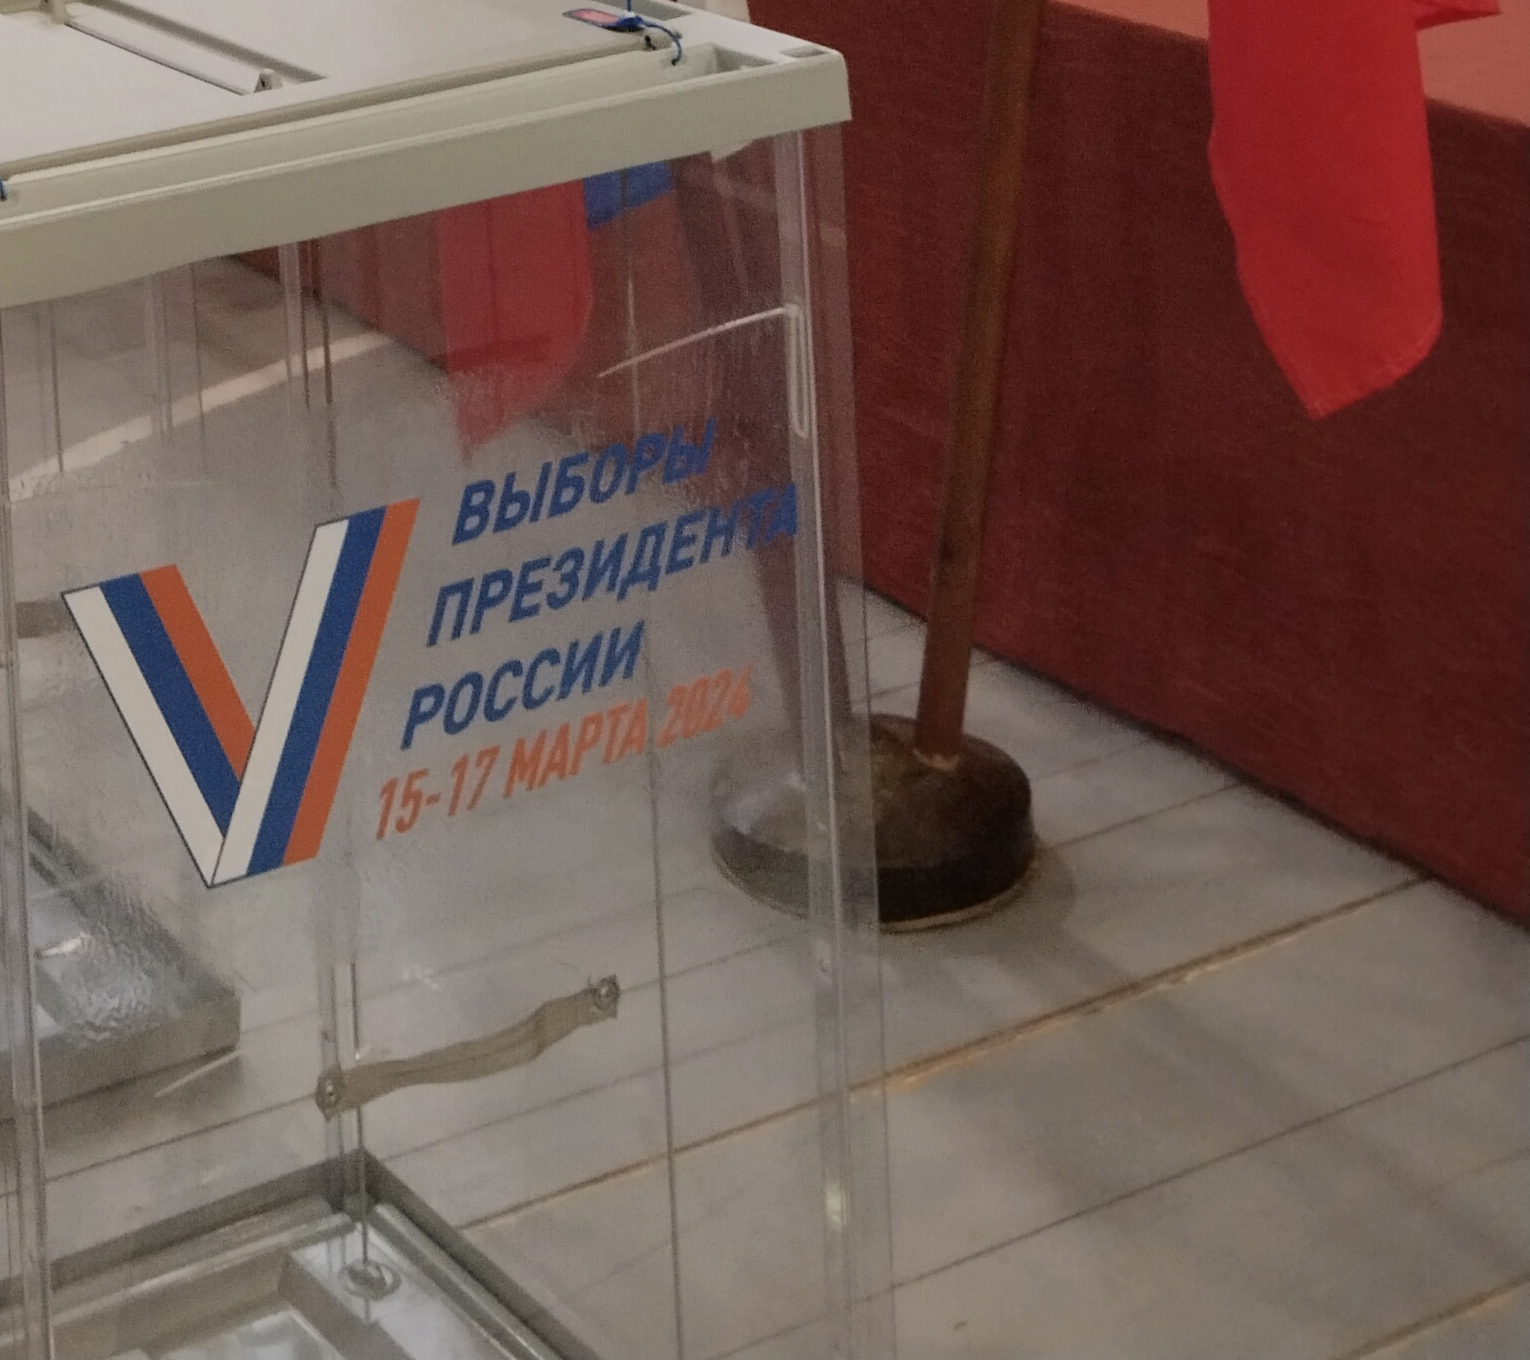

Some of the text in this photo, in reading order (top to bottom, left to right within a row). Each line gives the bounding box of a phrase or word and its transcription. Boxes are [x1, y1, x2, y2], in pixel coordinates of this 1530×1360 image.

[451, 418, 716, 544] ВЫБОРЫ
[426, 483, 798, 647] ПРЕЗИДЕНТА
[400, 620, 645, 749] РОССИИ
[374, 744, 501, 840] 15-17
[503, 698, 648, 798] МАРТА
